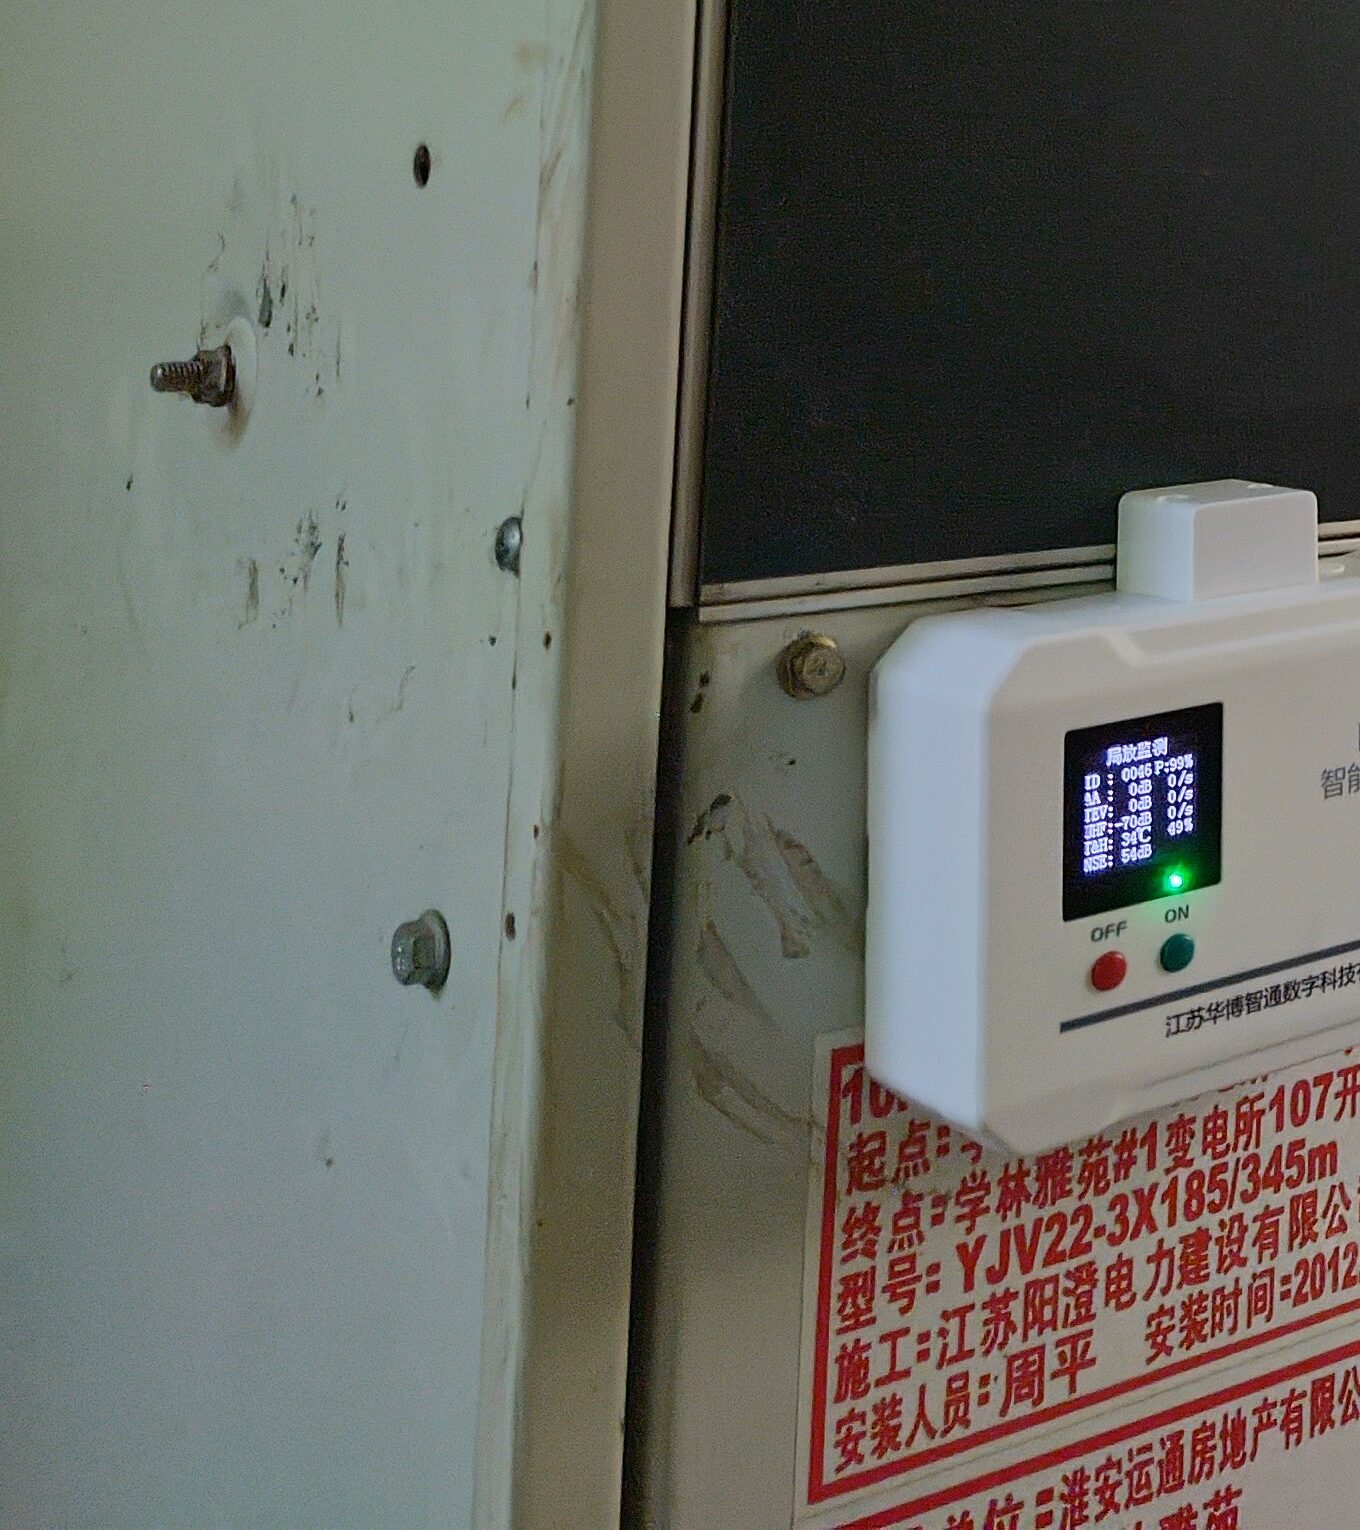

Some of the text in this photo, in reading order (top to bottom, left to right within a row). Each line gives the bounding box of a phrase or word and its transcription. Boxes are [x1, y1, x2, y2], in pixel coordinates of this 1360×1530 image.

[1105, 736, 1169, 767] 局放监测
[1128, 779, 1153, 797] 0dB
[1167, 770, 1194, 788] 0/s
[1128, 795, 1153, 813] 0dB
[1167, 786, 1194, 804] 0/s
[1167, 802, 1194, 820] 0/s
[1164, 905, 1190, 925] ON
[1090, 920, 1128, 944] OFF
